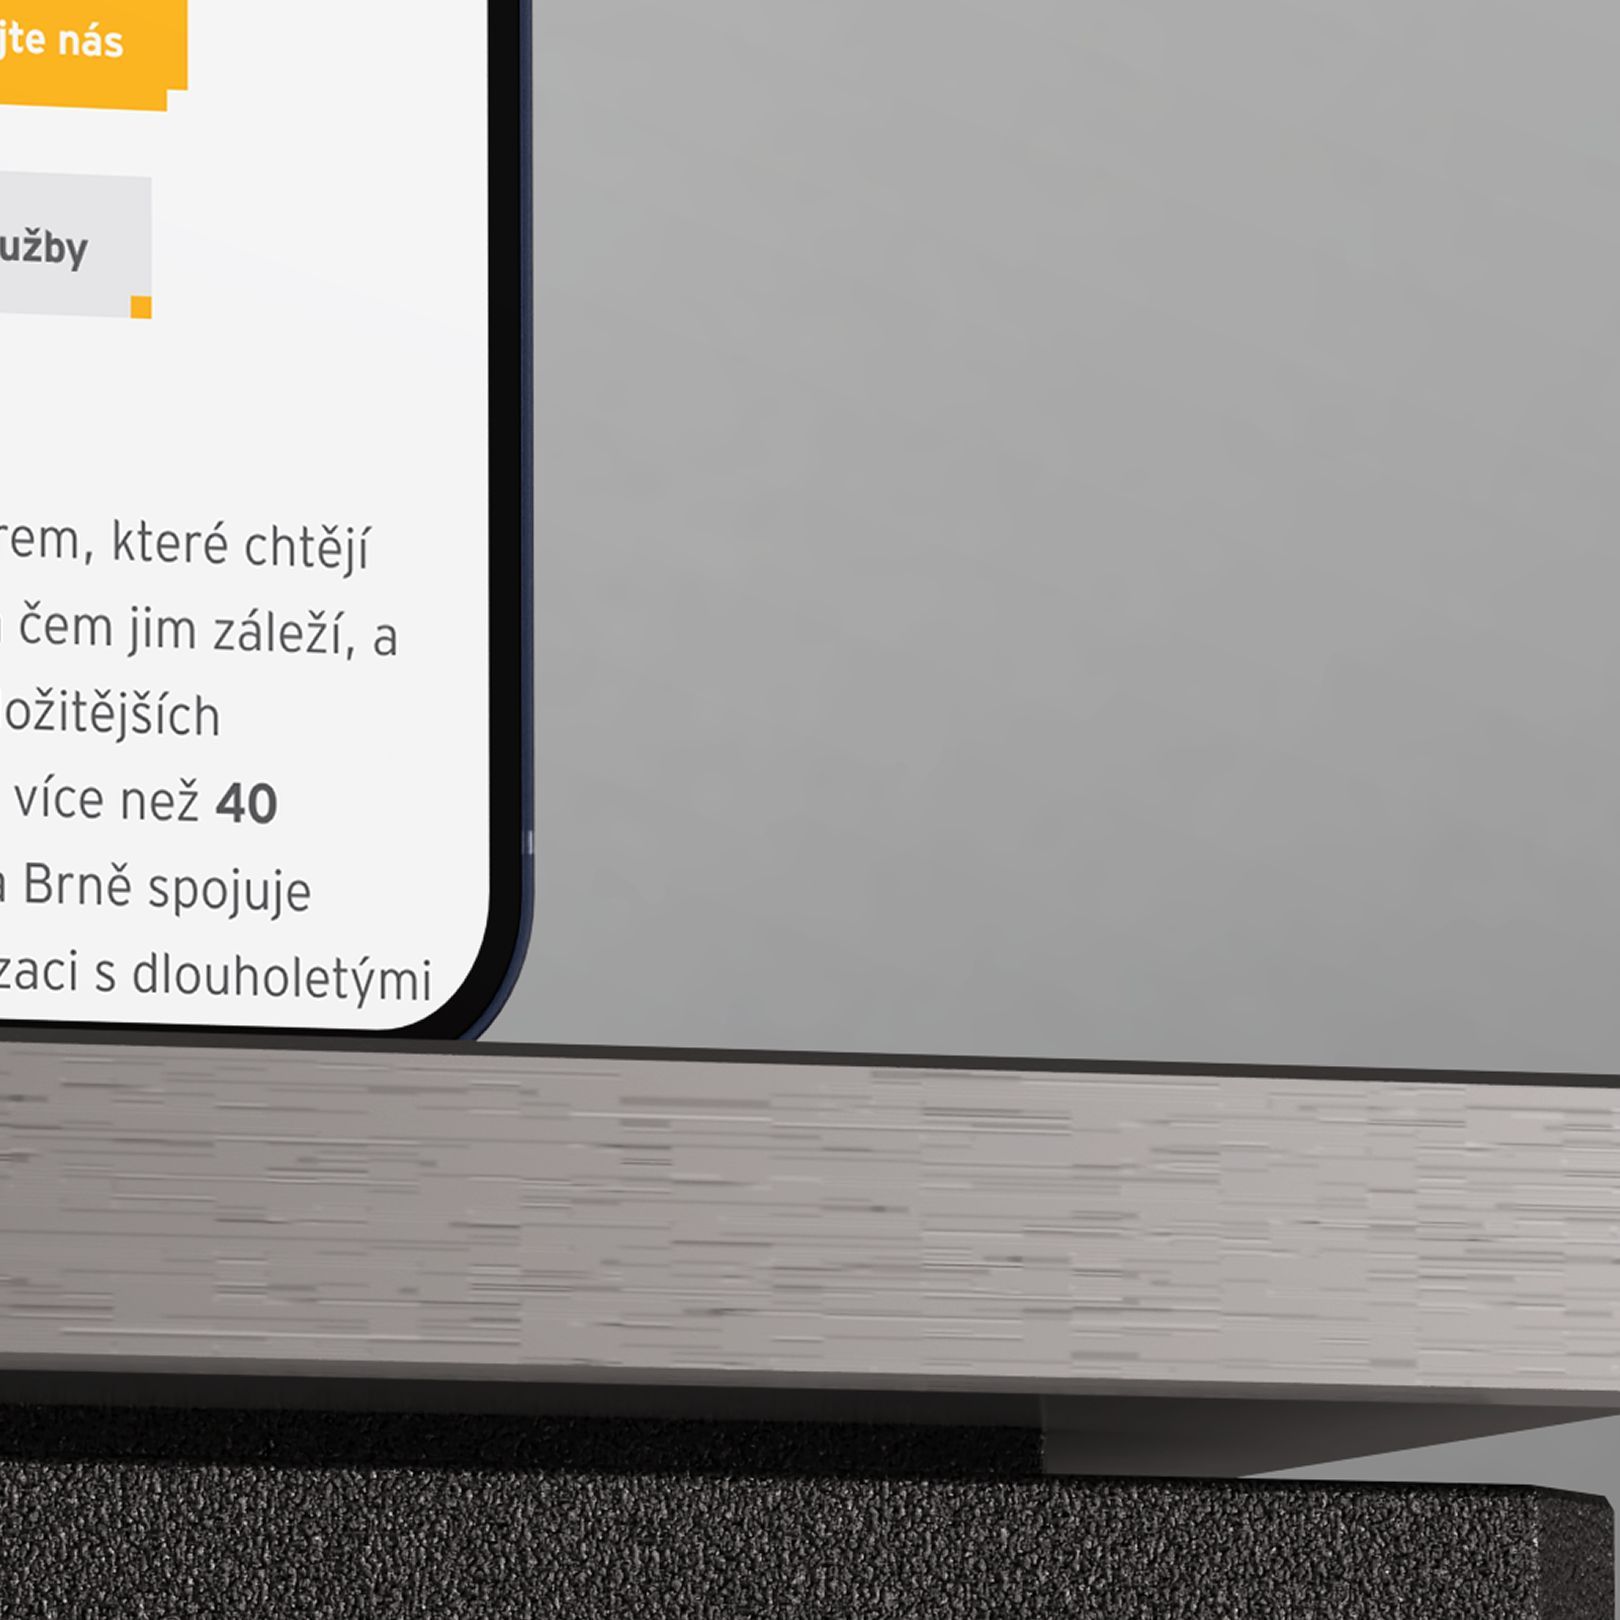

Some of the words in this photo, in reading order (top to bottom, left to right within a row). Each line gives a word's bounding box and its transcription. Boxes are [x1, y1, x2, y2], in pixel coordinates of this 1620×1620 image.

[58, 20, 124, 58] nás
[114, 518, 228, 565] které
[245, 524, 372, 579] chtějí
[20, 599, 112, 647] čem
[127, 605, 195, 658] jim
[213, 607, 354, 661] záleží,
[373, 624, 397, 656] a
[14, 773, 104, 819] více
[122, 777, 199, 822] než
[215, 782, 277, 825] 40
[25, 861, 132, 907] Brně
[149, 867, 311, 922] spojuje
[95, 960, 116, 993] s
[133, 951, 431, 1010] dlouholetými
